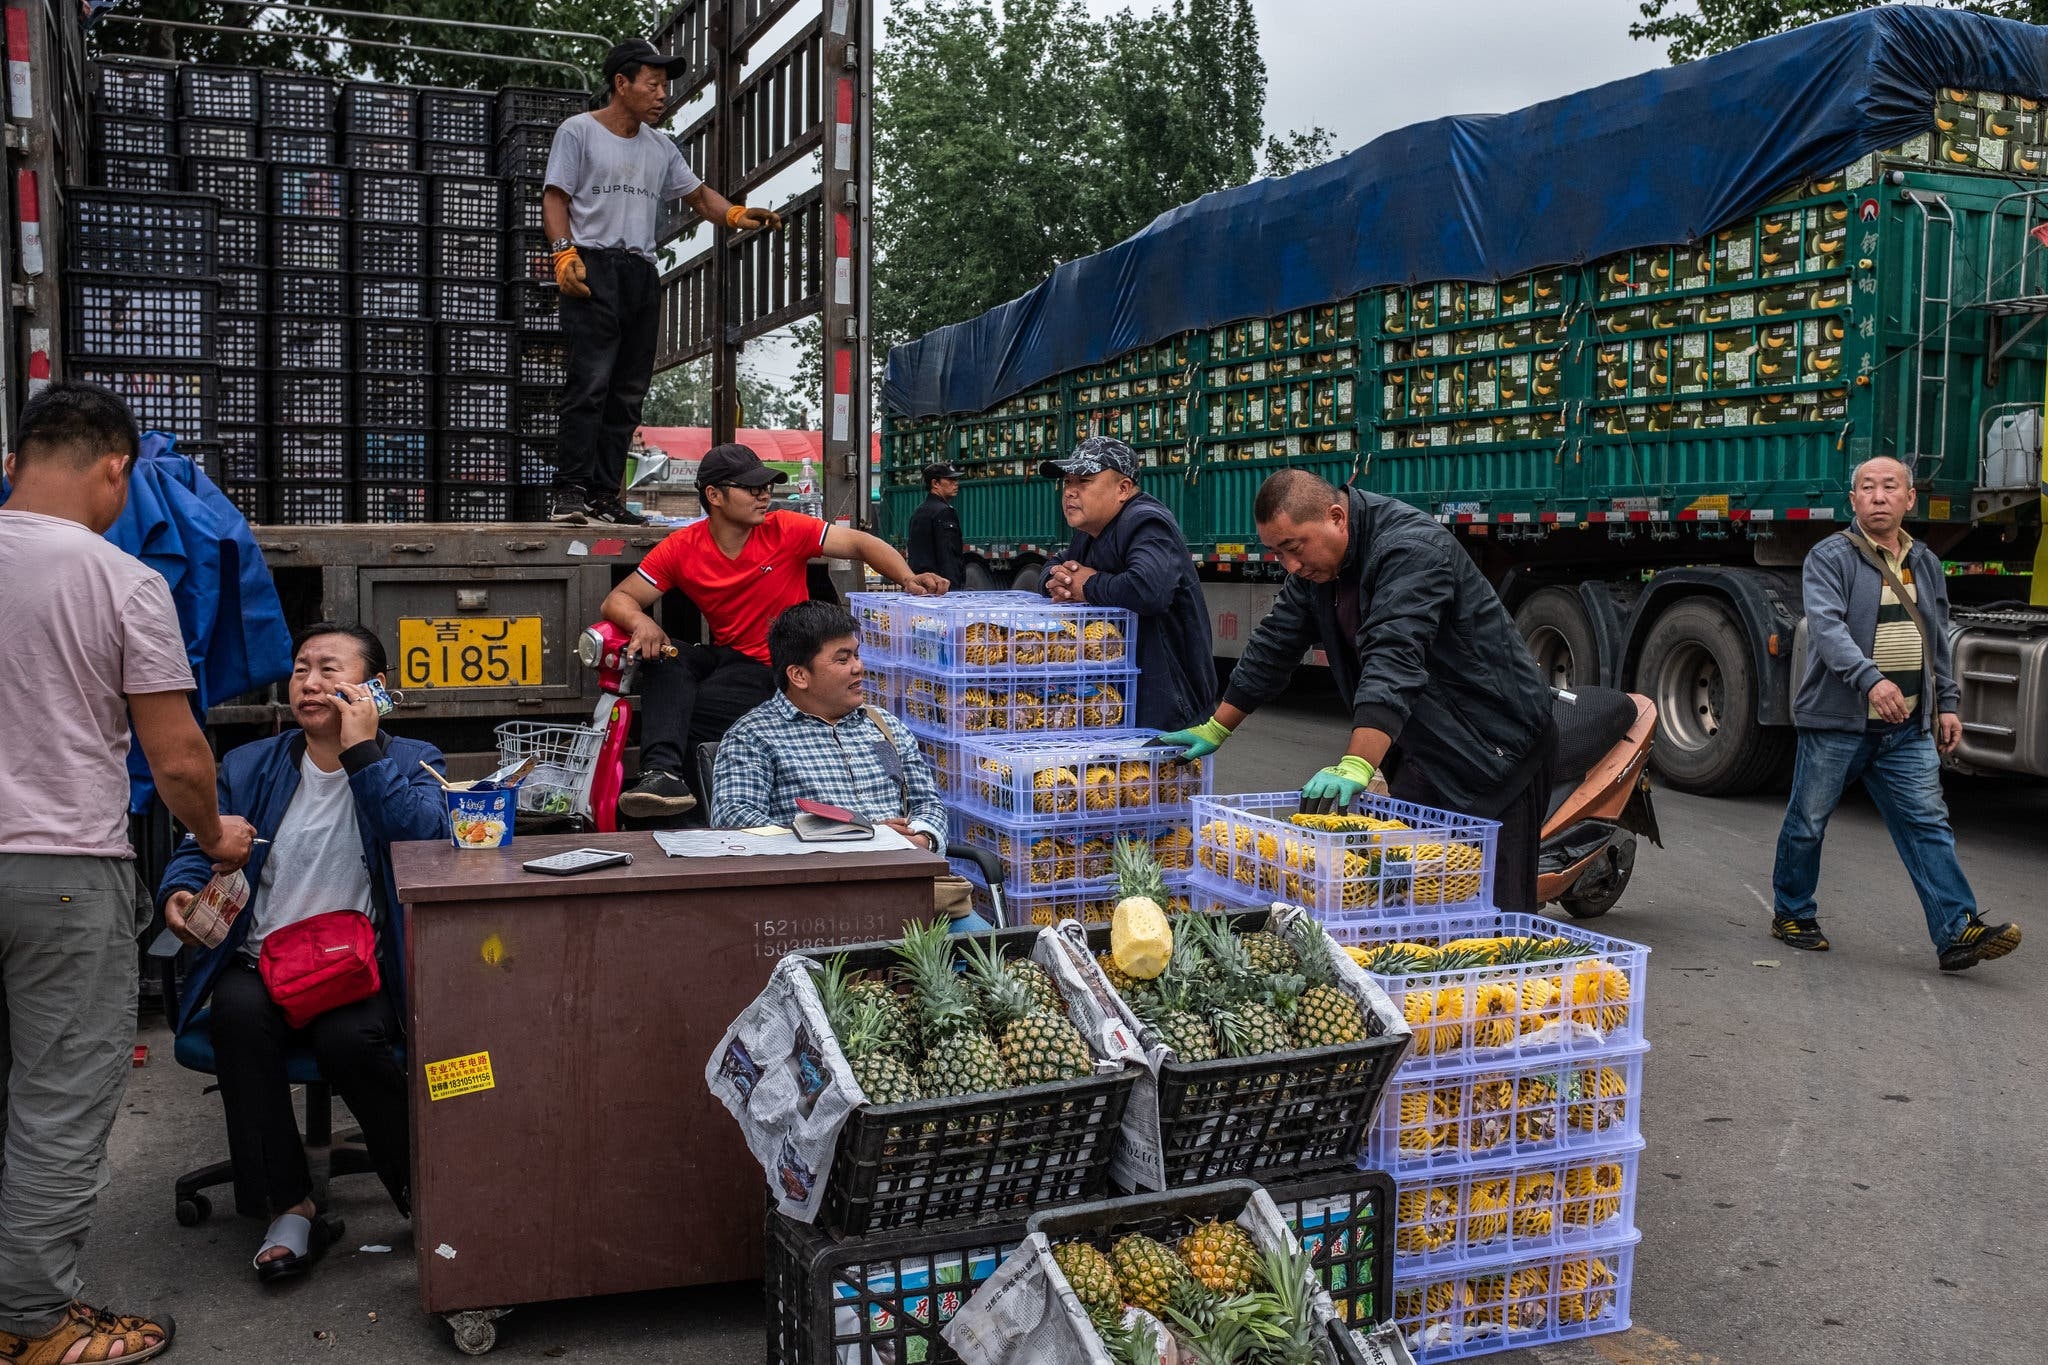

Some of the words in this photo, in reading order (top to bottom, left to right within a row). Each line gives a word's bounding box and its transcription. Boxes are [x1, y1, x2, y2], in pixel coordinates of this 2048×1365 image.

[407, 644, 527, 683] G1851
[753, 914, 885, 937] 15210816131
[429, 1055, 487, 1075] 专业汽车电路
